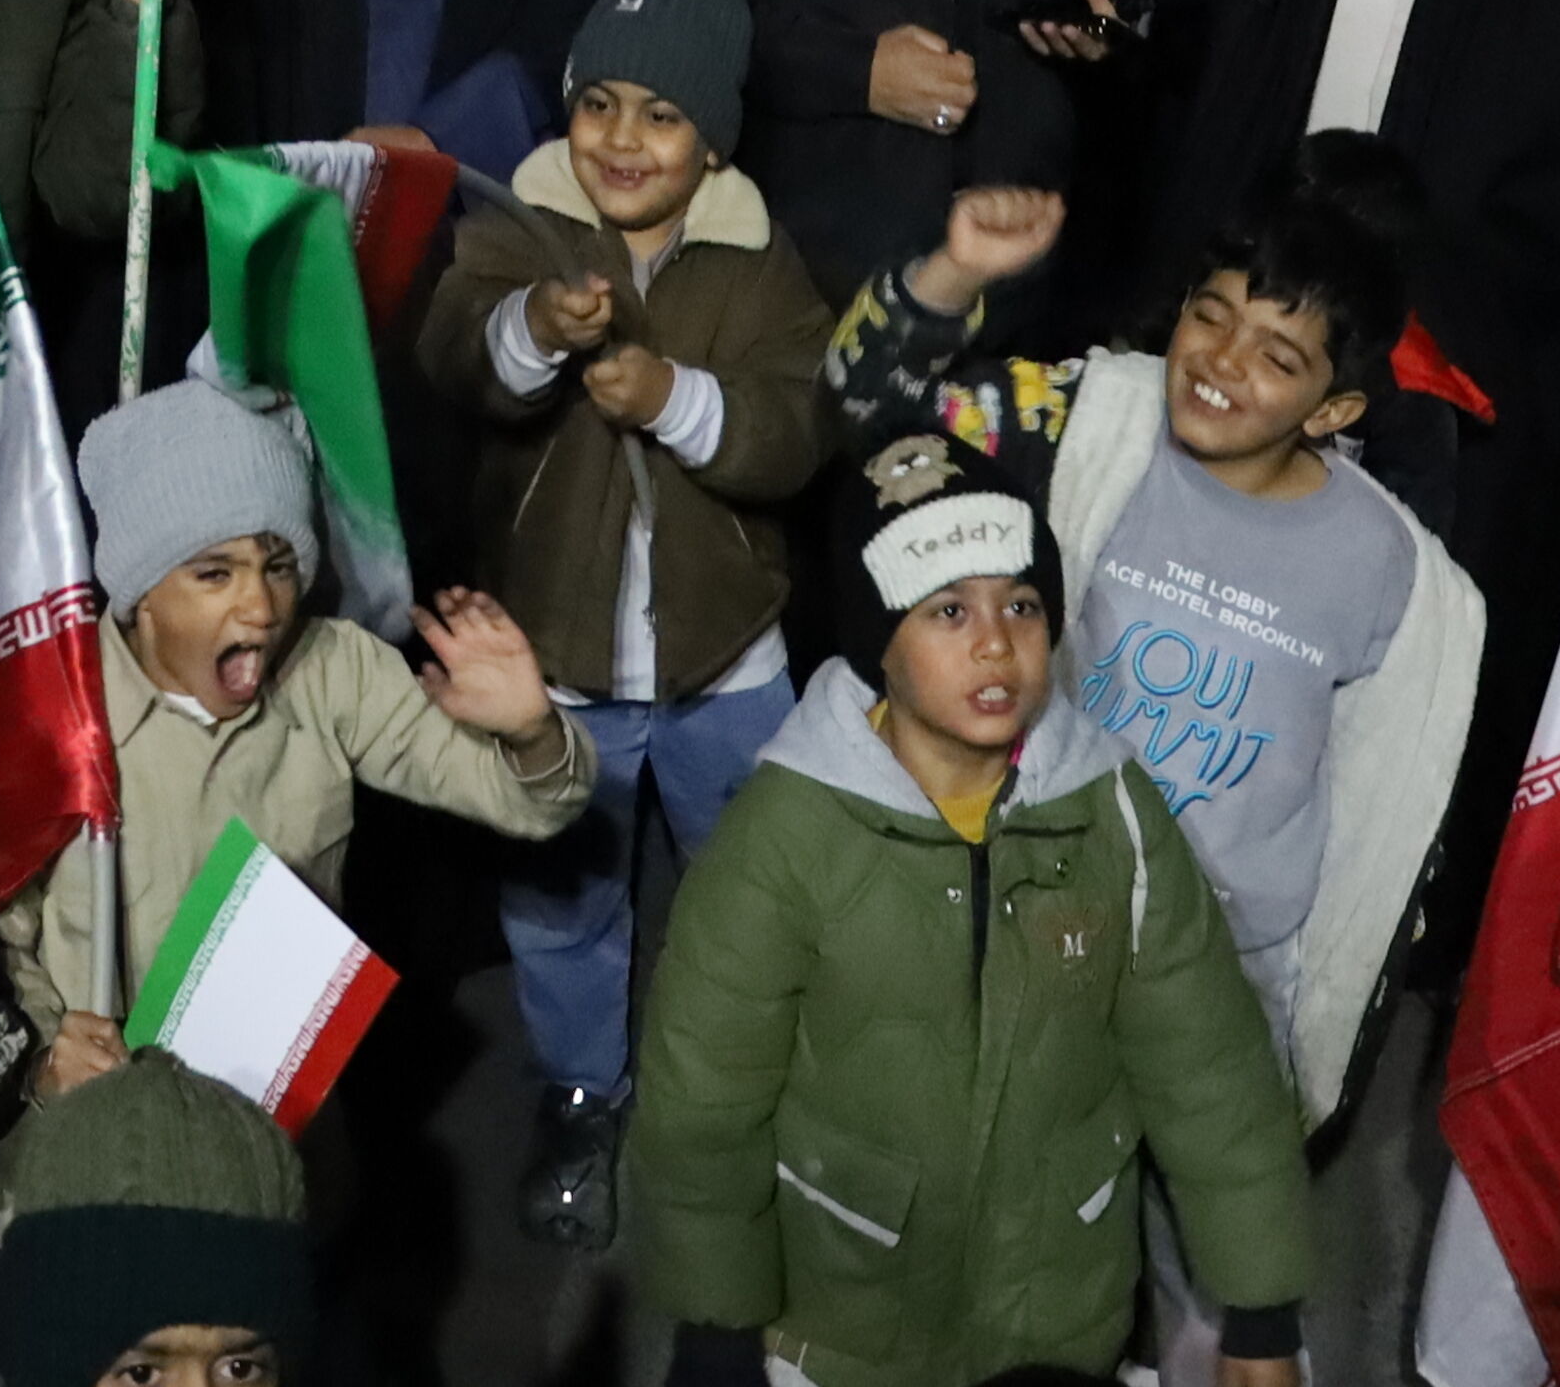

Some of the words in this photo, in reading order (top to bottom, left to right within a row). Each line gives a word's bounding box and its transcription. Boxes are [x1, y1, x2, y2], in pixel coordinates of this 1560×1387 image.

[902, 521, 1016, 559] Teddy
[1104, 559, 1145, 588] ACE
[1147, 577, 1214, 618] HOTEL
[1218, 606, 1326, 668] BROOKLYN
[1166, 560, 1207, 591] THE
[1207, 579, 1282, 621] LOBBY
[1062, 930, 1086, 958] M
